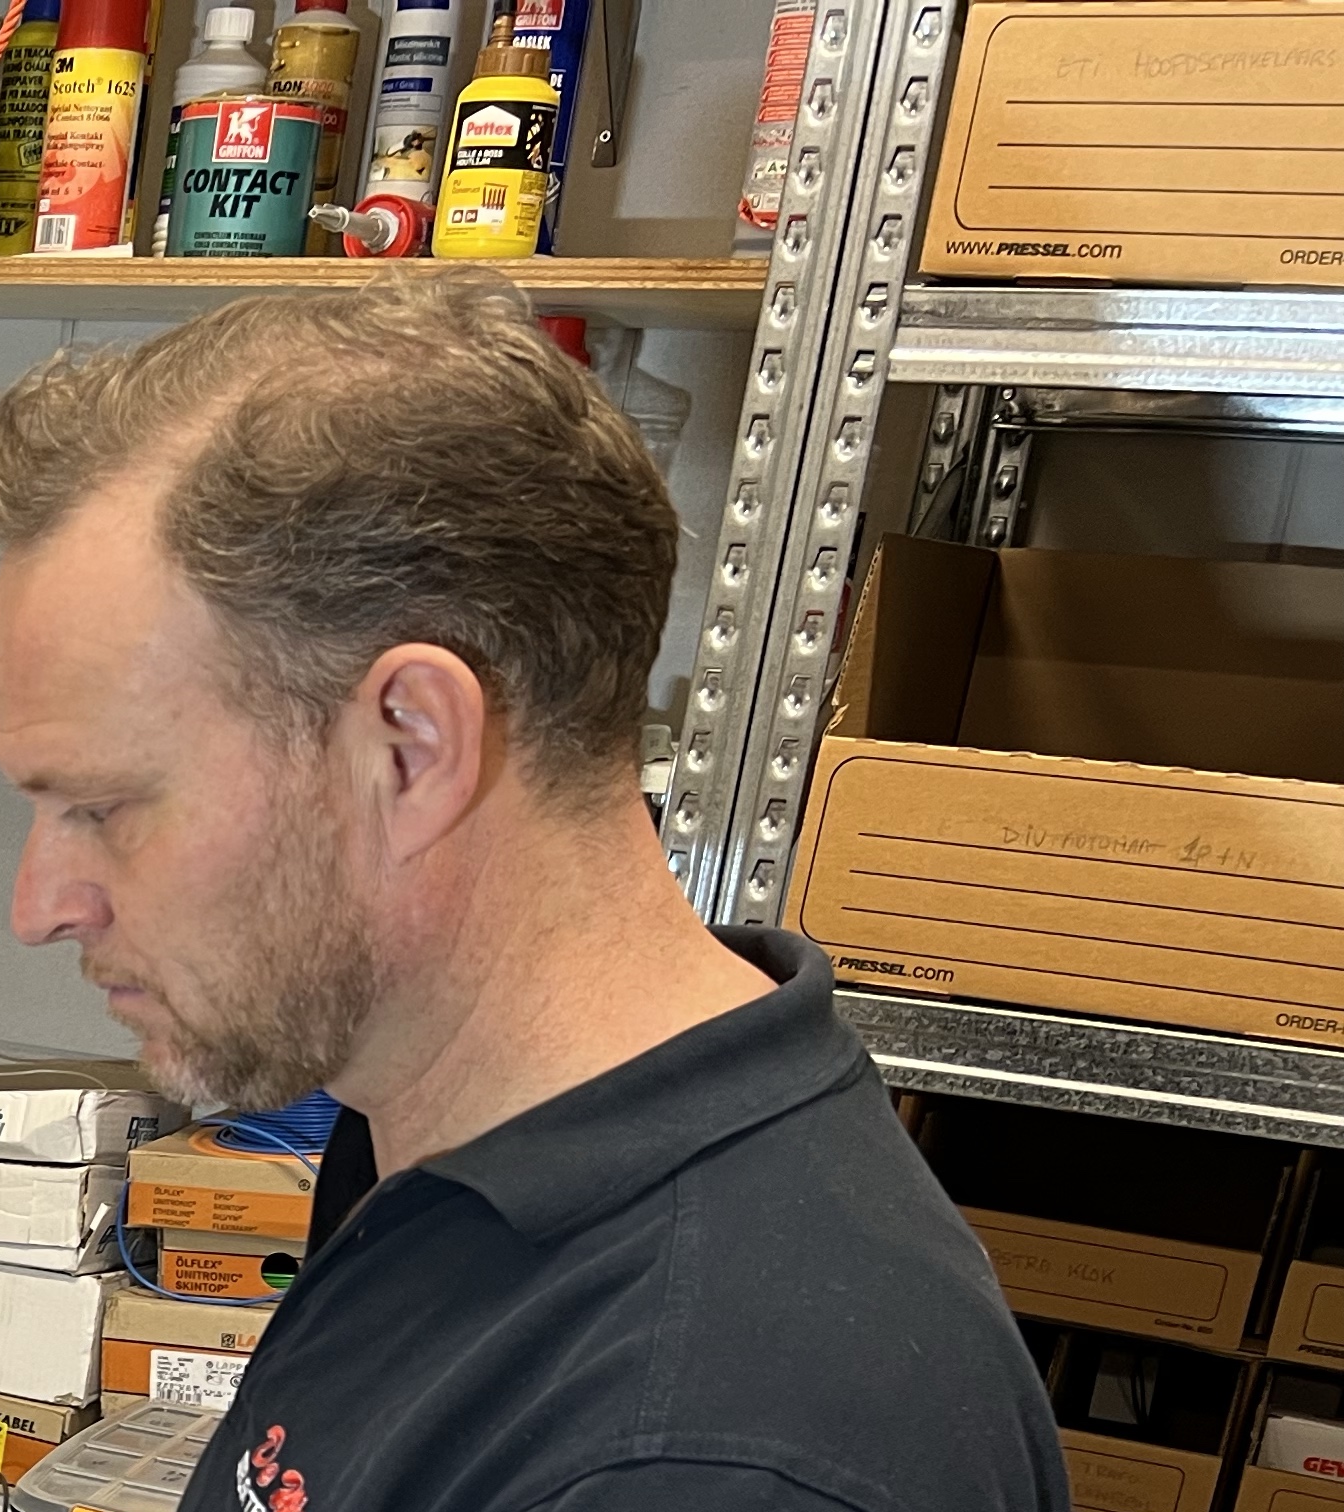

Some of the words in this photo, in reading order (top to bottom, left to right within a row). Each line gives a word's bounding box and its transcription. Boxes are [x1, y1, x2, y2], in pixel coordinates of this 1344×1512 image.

[515, 14, 556, 26] GRIFFON
[512, 36, 552, 50] GASLEK
[55, 57, 74, 73] 3M
[107, 80, 136, 97] 1625
[272, 81, 302, 93] FLON
[465, 121, 513, 136] Pattex
[219, 145, 264, 159] GRIFFON
[183, 168, 300, 196] CONTACT
[209, 195, 261, 219] KIT
